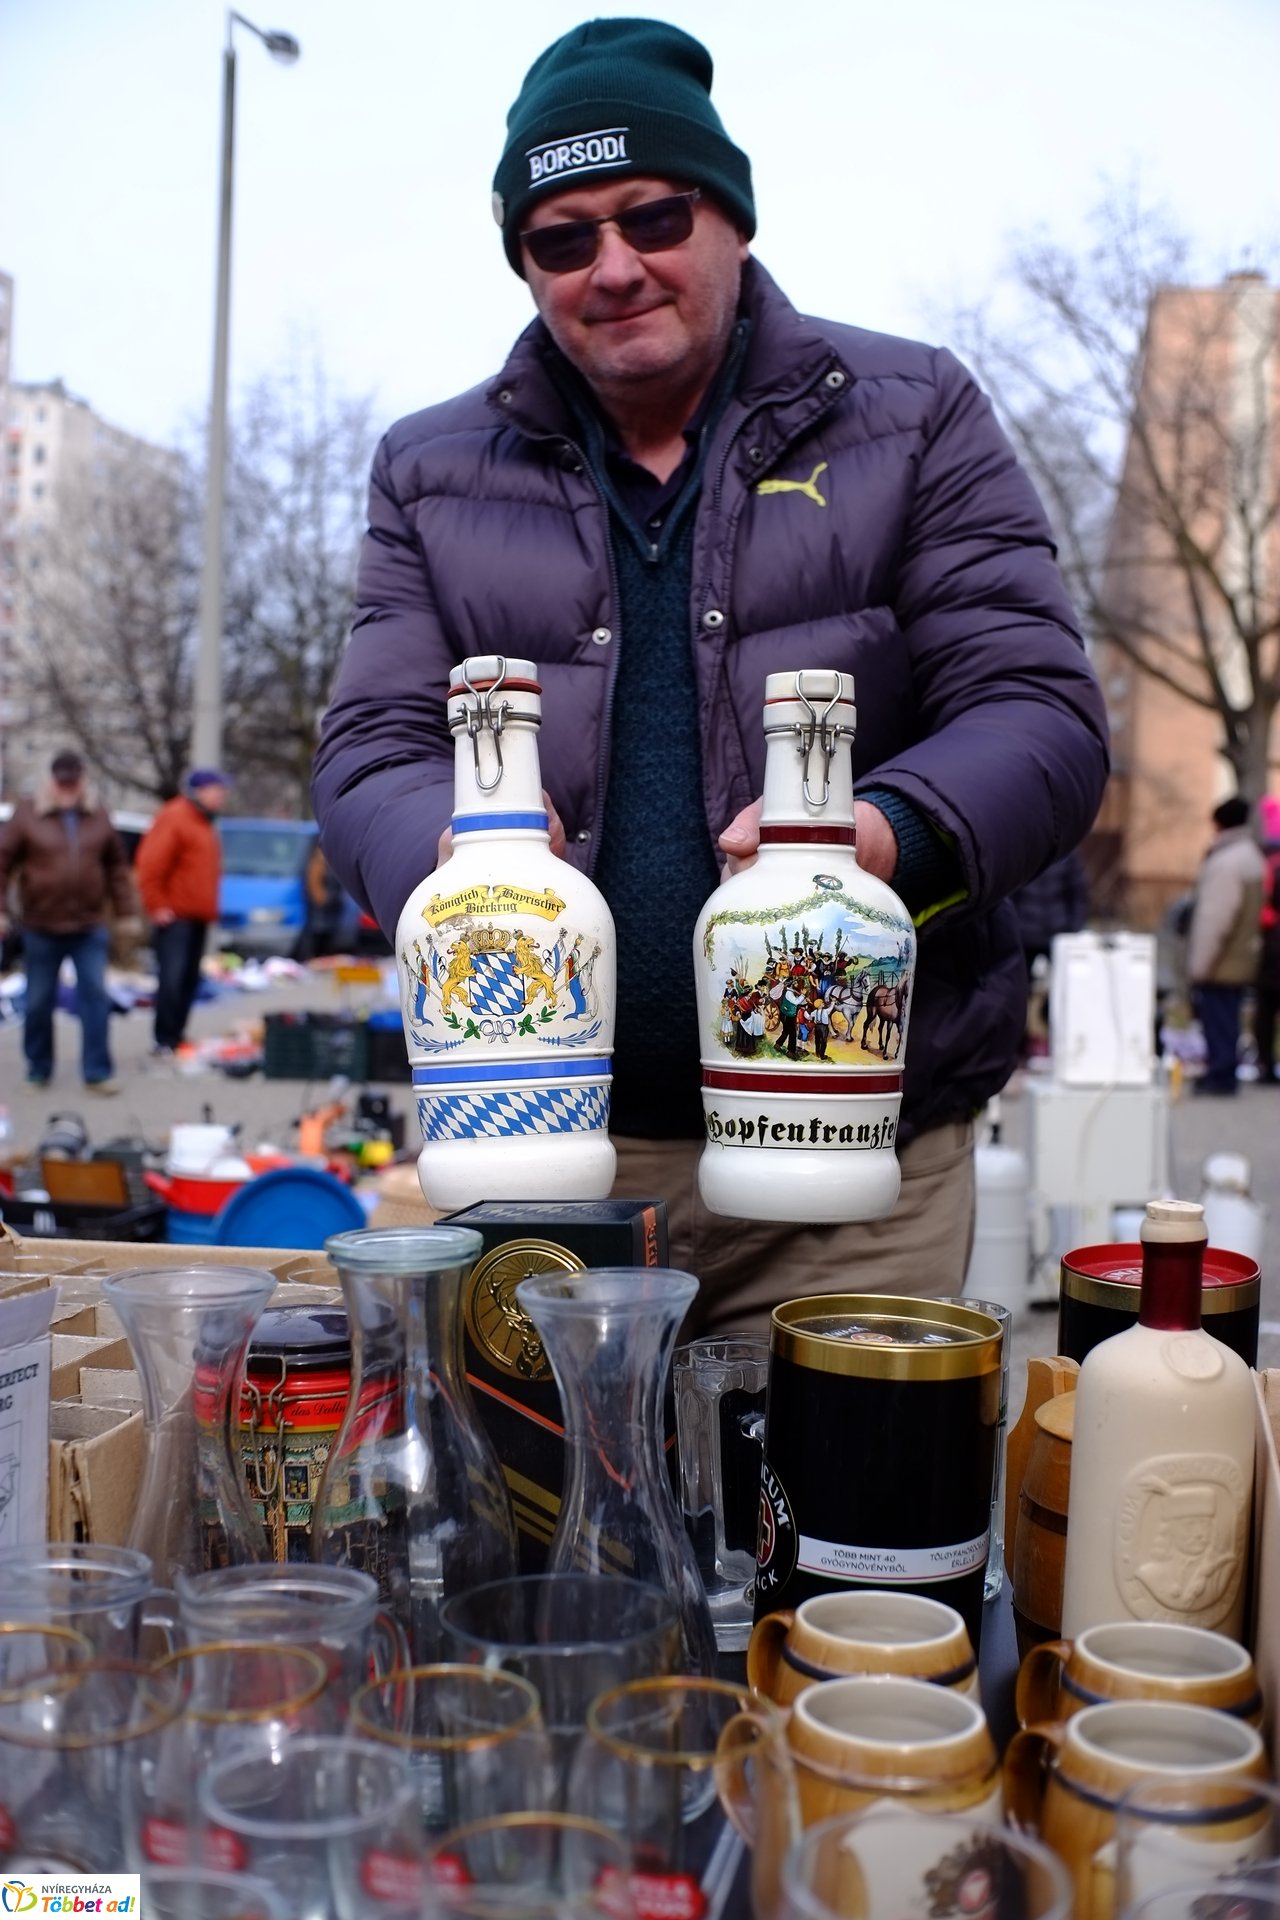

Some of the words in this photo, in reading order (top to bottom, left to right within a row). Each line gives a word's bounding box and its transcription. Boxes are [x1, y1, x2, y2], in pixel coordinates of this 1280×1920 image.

[529, 135, 626, 180] BORSODI
[430, 889, 479, 916] Königlich
[501, 887, 562, 913] Bayrischer
[465, 902, 517, 914] Bierkrug
[833, 1549, 857, 1559] TÖBB
[859, 1553, 881, 1562] MINT
[884, 1554, 896, 1562] 40
